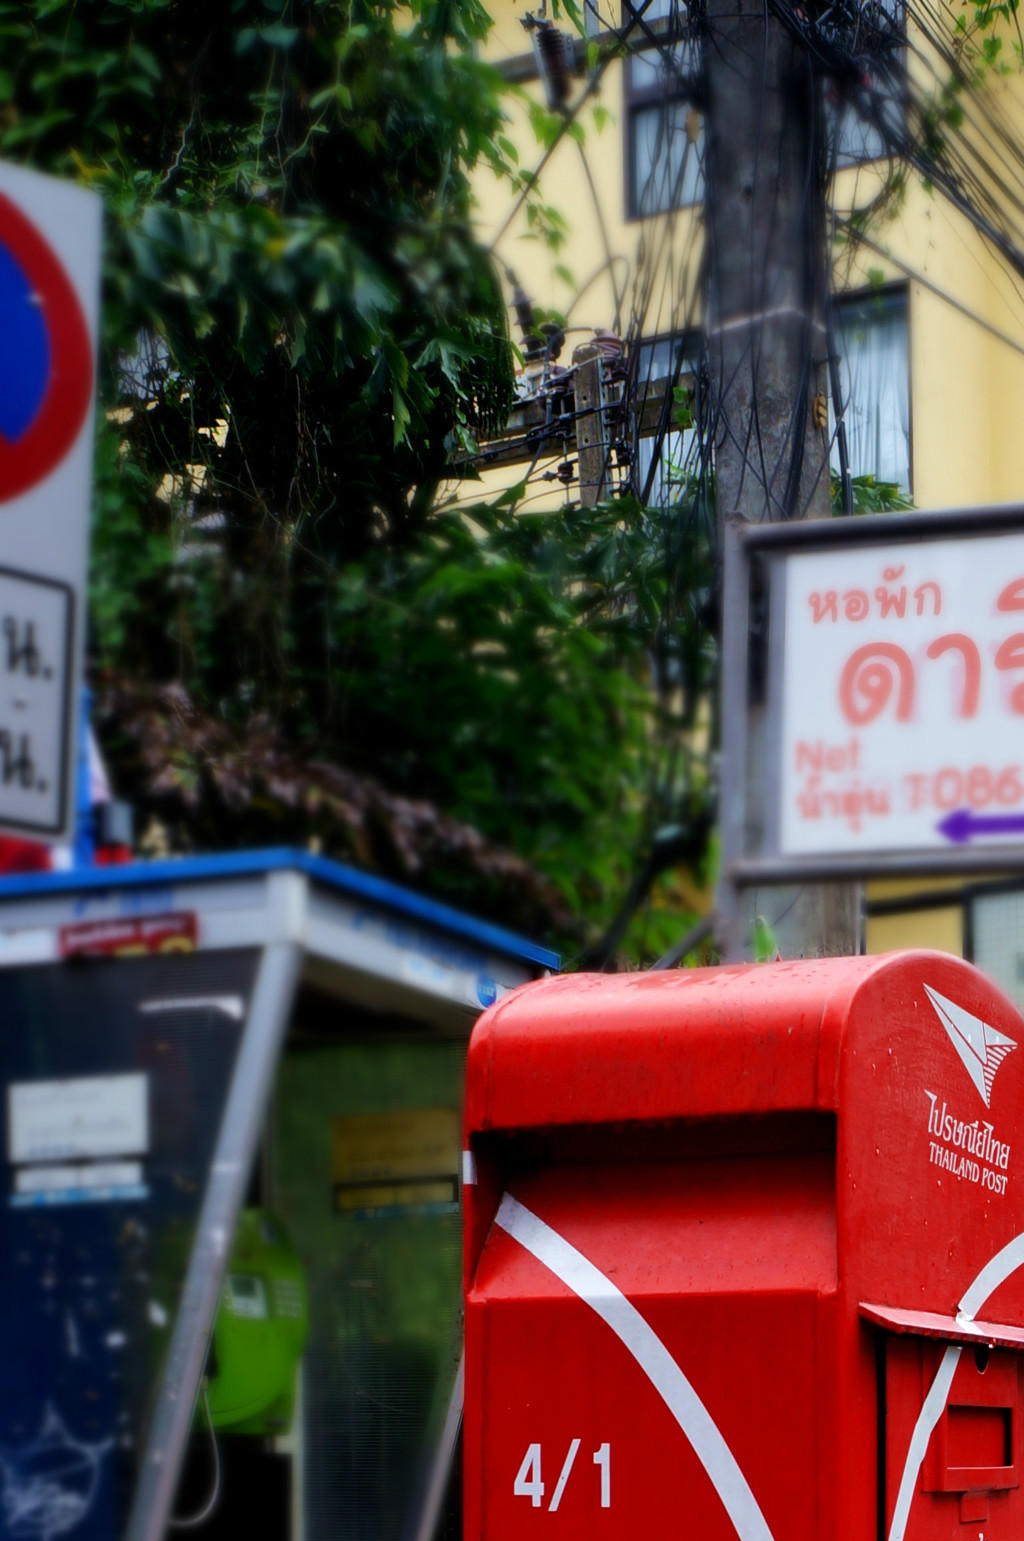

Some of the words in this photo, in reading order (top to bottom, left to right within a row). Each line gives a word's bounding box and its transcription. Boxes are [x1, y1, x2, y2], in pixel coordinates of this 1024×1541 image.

[809, 566, 942, 624] หอพัก
[796, 733, 861, 773] Net
[923, 1088, 1011, 1170] ไปรษณีย์ไทย
[929, 1141, 980, 1183] THAILAND
[981, 1167, 1009, 1195] POST
[513, 1438, 611, 1512] 4/1
